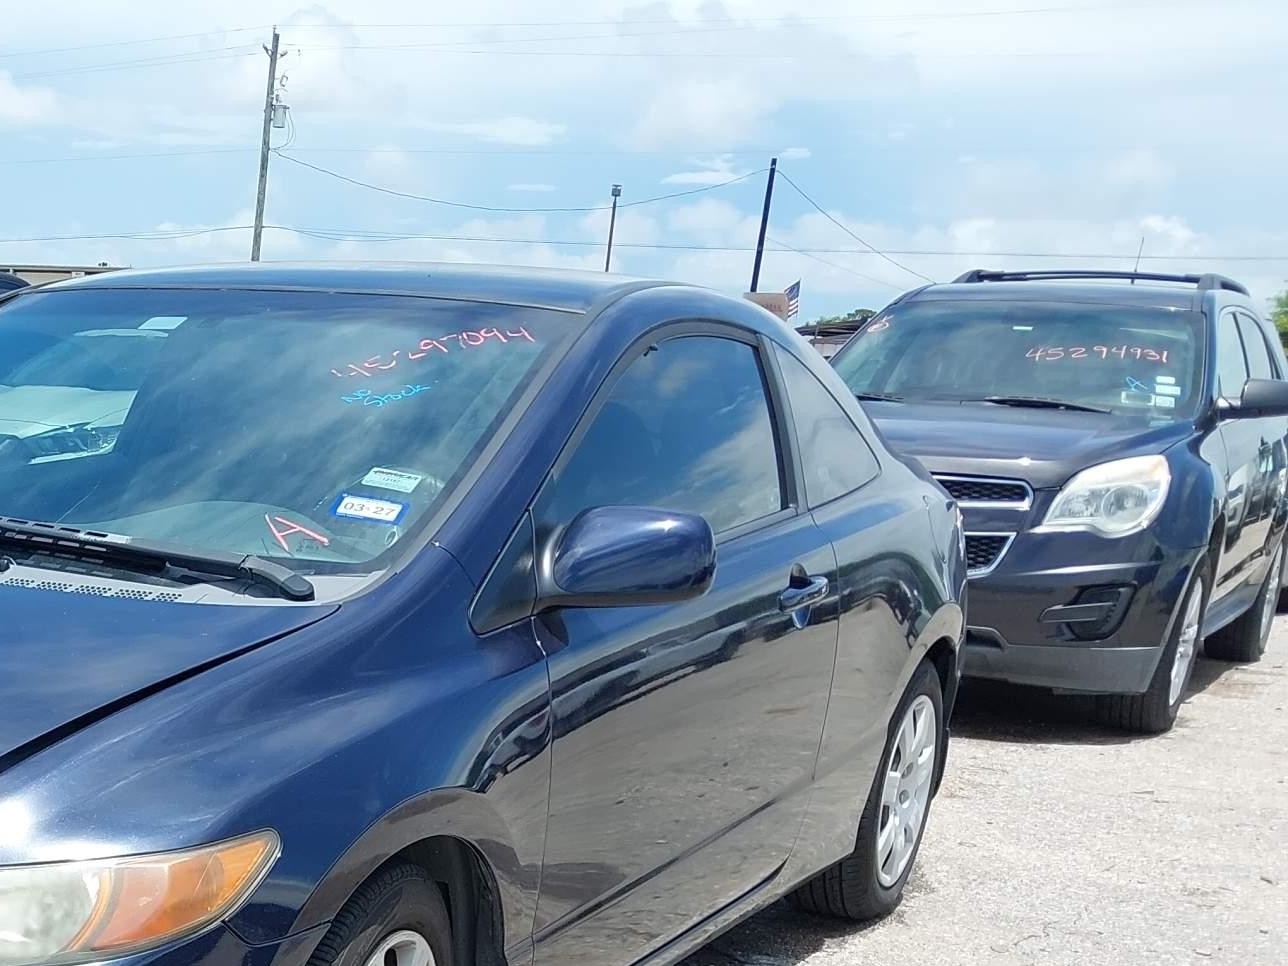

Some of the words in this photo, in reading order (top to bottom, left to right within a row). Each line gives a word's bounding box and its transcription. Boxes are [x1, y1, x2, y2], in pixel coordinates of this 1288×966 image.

[1025, 345, 1168, 363] 45294931
[343, 502, 365, 512] 03
[372, 506, 396, 516] 27
[264, 512, 329, 552] A
